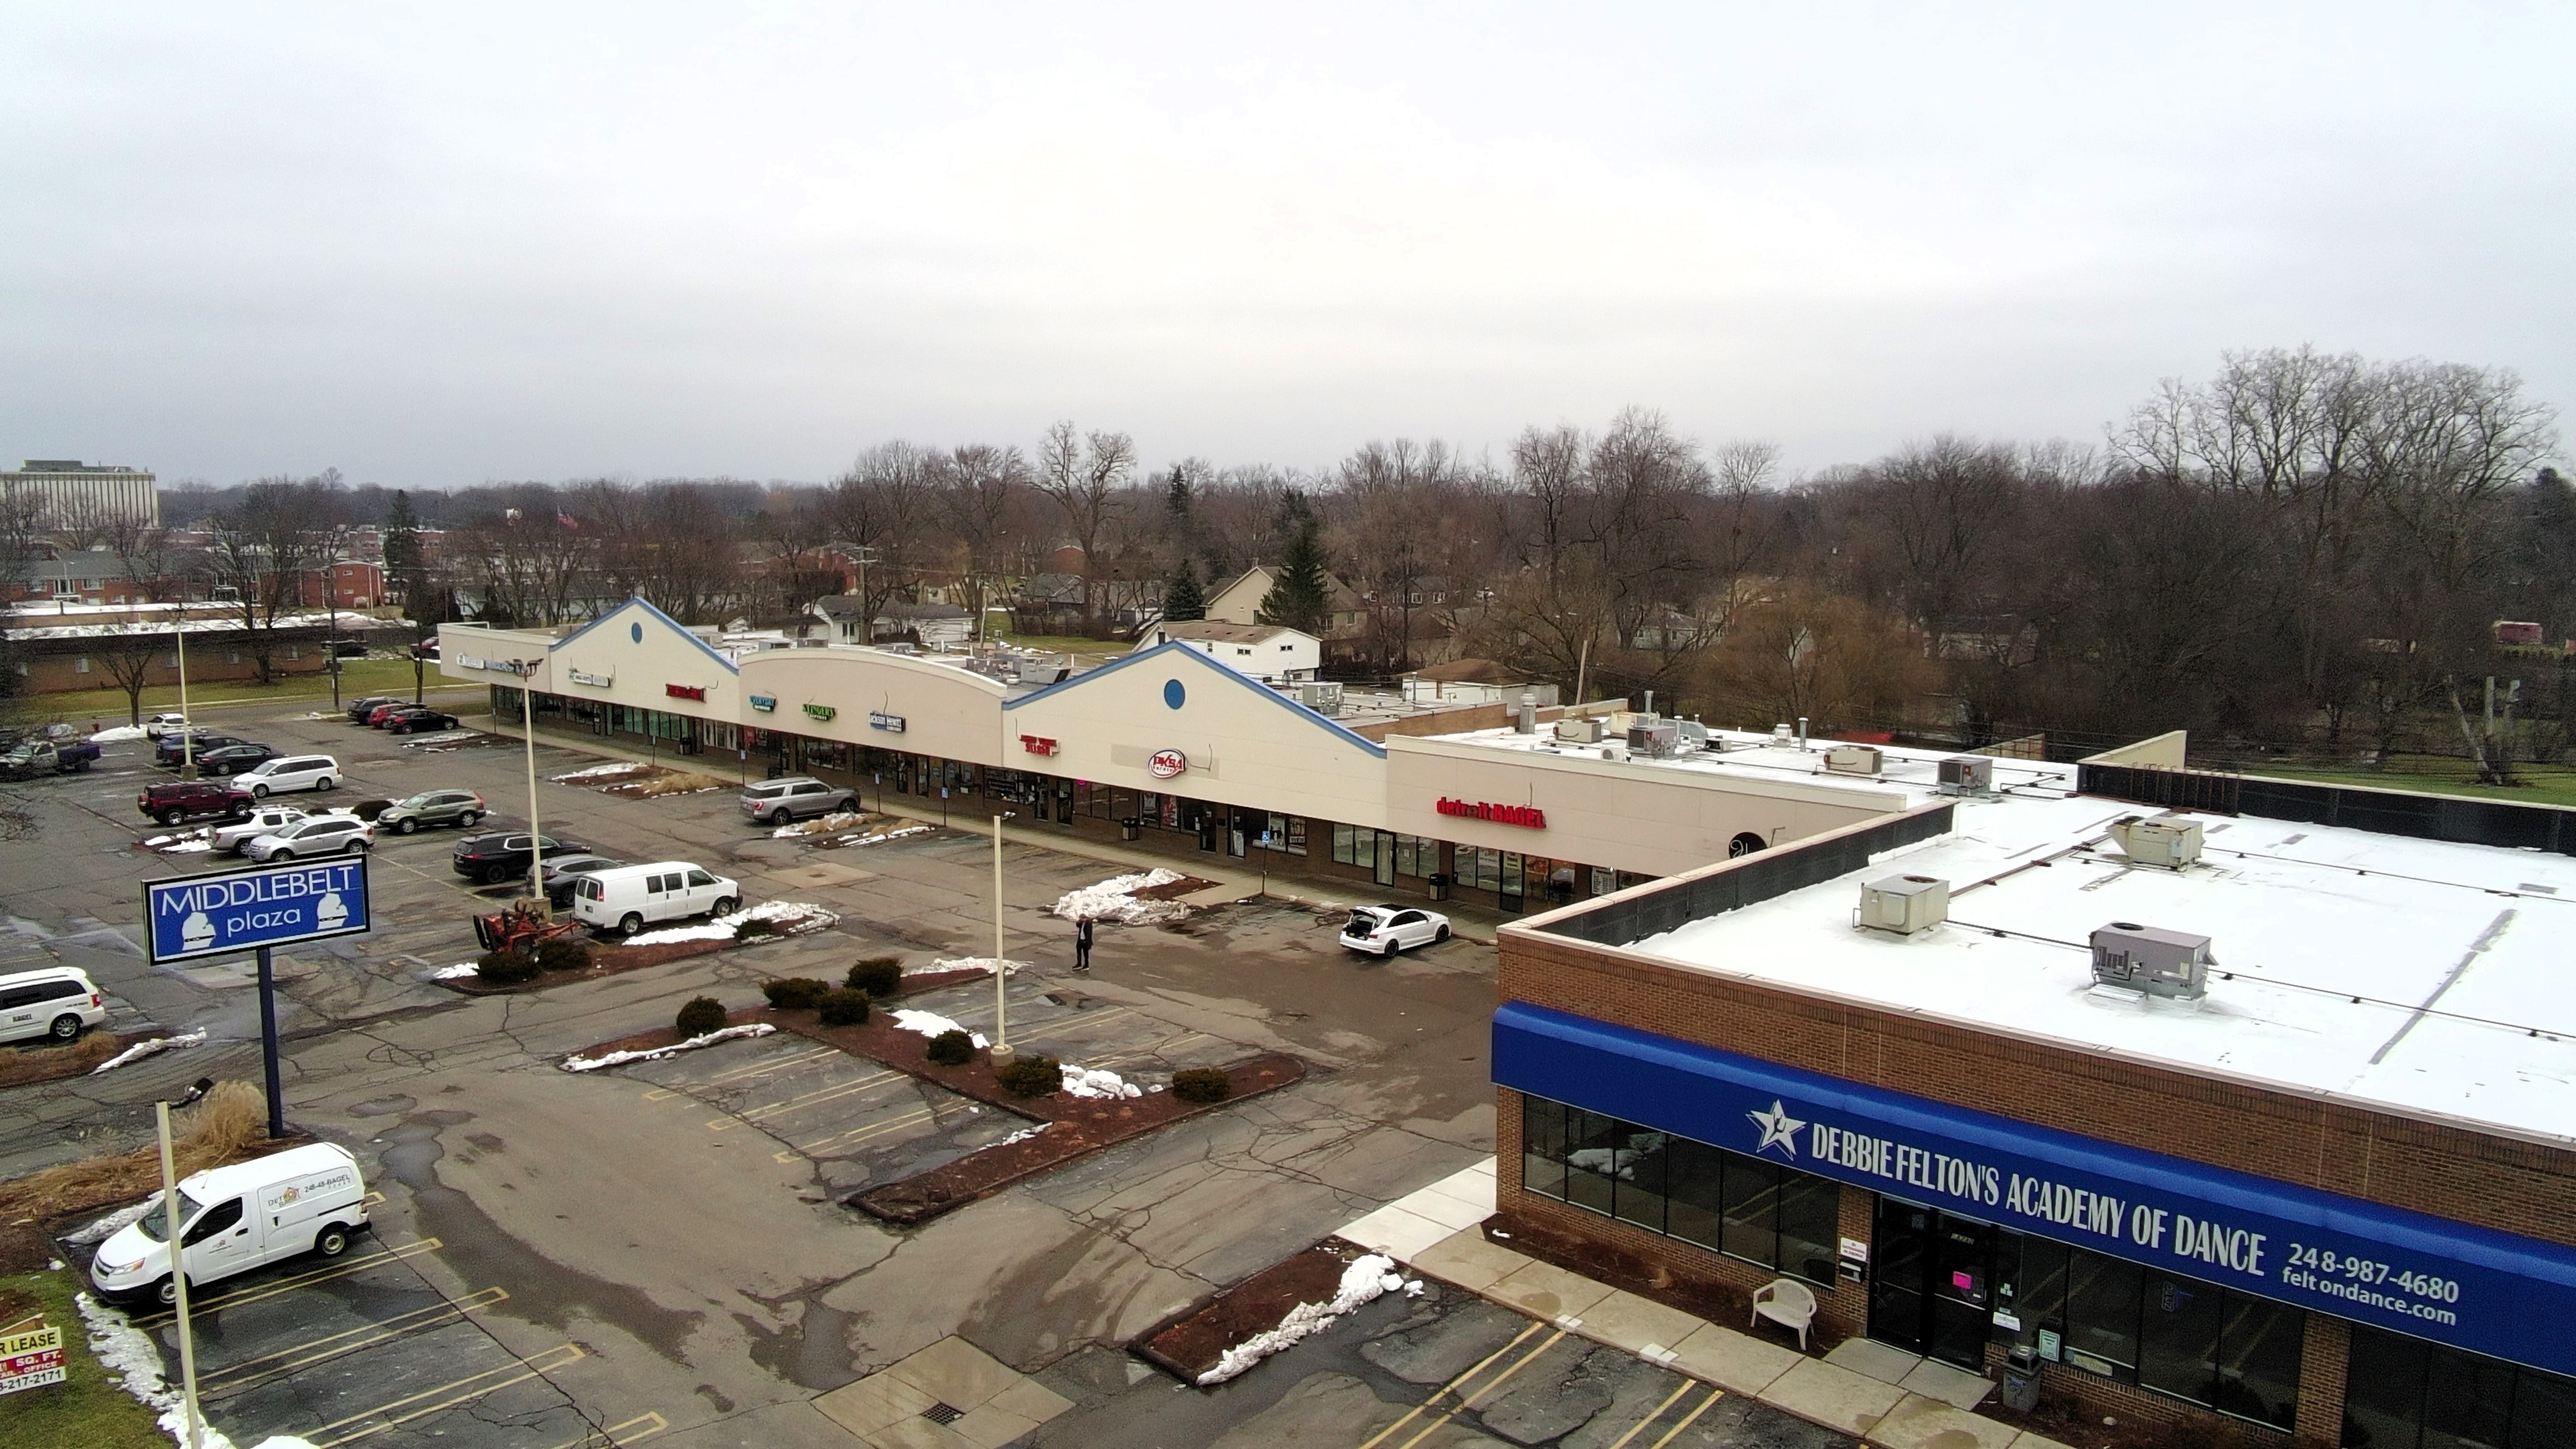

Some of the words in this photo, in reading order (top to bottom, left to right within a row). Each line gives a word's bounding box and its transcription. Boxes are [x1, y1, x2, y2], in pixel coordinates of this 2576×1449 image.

[1153, 754, 1182, 769] PKSA
[1492, 803, 1546, 829] BAGEL
[162, 866, 354, 916] MIDDLEBELT
[227, 908, 301, 937] plaza
[1812, 1123, 1893, 1178] DEBBIE
[1896, 1144, 2000, 1206] FELTON'S
[2006, 1173, 2126, 1238] ACADEMY
[2132, 1205, 2169, 1249] OF
[2175, 1214, 2267, 1276] DANCE
[2288, 1243, 2459, 1304] 248-987-4680
[11, 1332, 56, 1352] LEASE
[16, 1356, 39, 1366] SQ.
[42, 1350, 62, 1361] FT.
[23, 1361, 58, 1373] OFFICE
